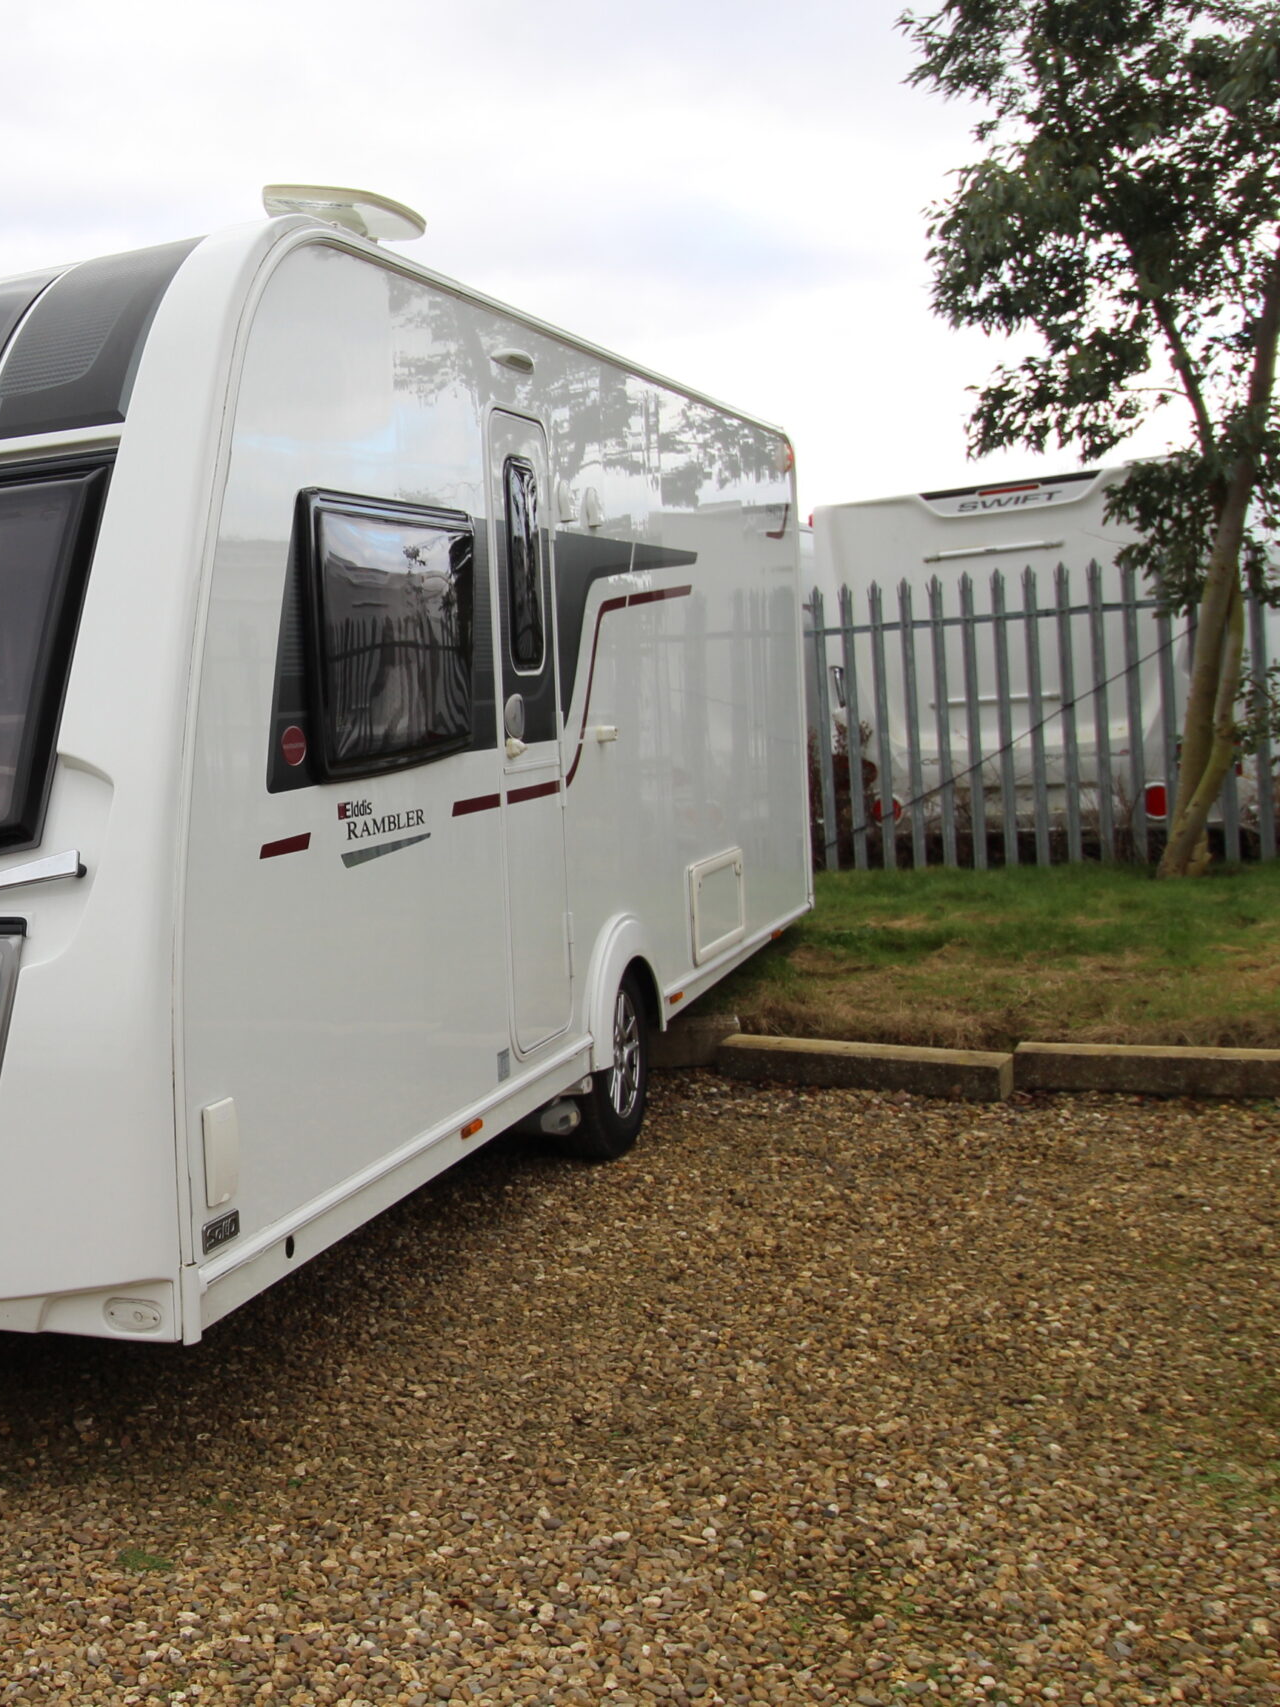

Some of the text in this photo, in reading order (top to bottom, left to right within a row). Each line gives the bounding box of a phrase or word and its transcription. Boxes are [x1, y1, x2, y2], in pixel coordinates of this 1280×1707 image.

[957, 490, 1063, 513] SWIFT
[344, 799, 373, 819] Elddis
[346, 809, 425, 841] RAMBLER
